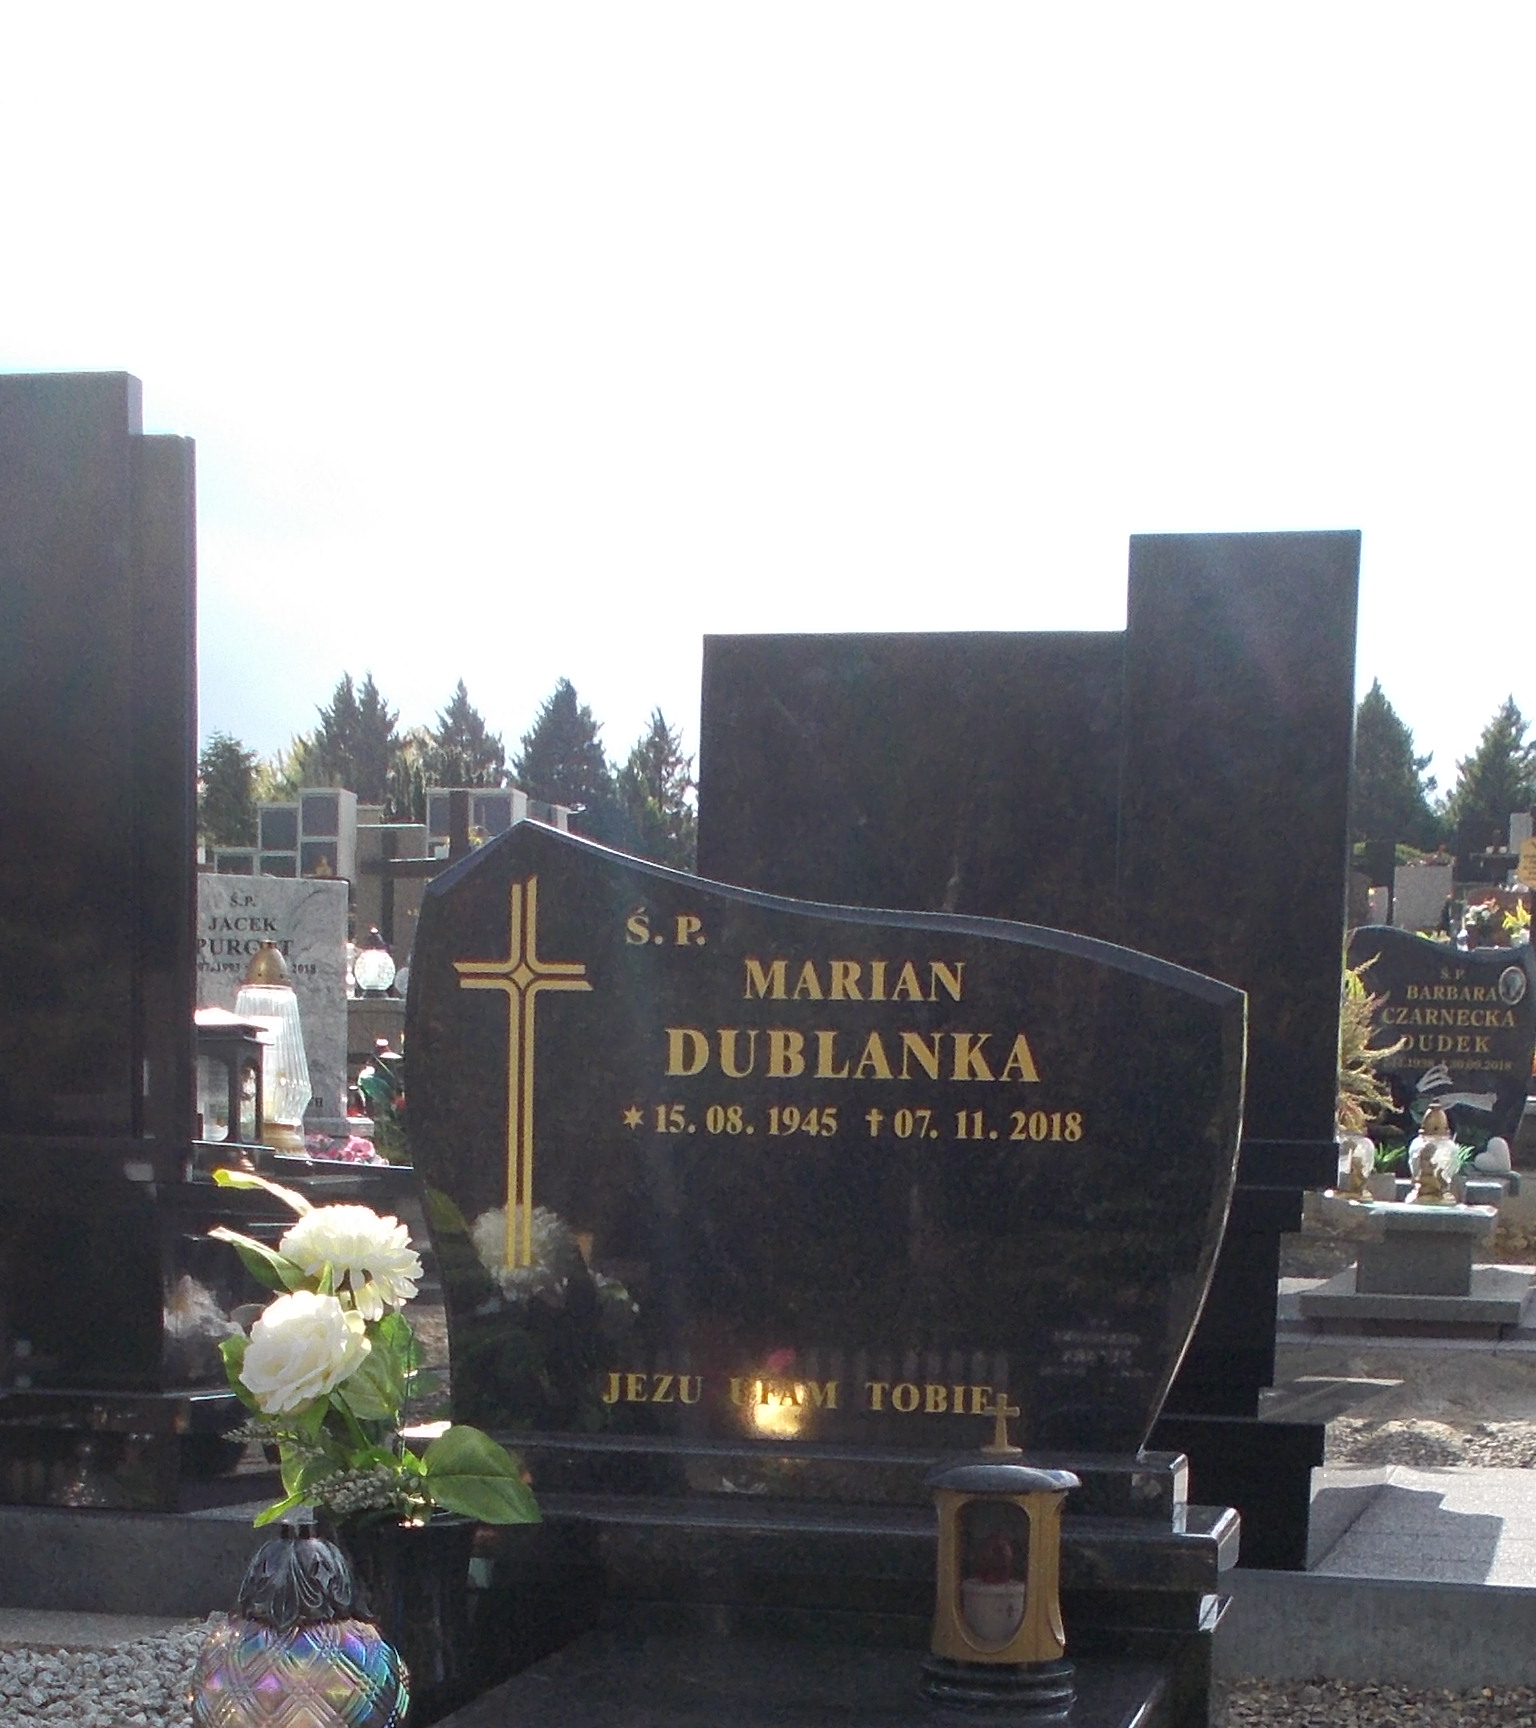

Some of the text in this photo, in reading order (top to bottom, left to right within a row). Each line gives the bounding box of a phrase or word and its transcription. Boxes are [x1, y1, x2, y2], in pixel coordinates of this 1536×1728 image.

[208, 917, 278, 932] JACEK
[625, 907, 708, 946] Ś. P.
[197, 939, 294, 956] PURGT
[743, 959, 966, 1001] MARIAN
[1407, 984, 1497, 1001] BARBARA
[1381, 1007, 1516, 1027] CZARNECKA
[664, 1027, 1041, 1083] DUBLANKA
[655, 1104, 1084, 1142] 15. 08. 1945 07. 11. 2018
[602, 1372, 703, 1405] JEZU
[865, 1380, 994, 1416] TOBIE
